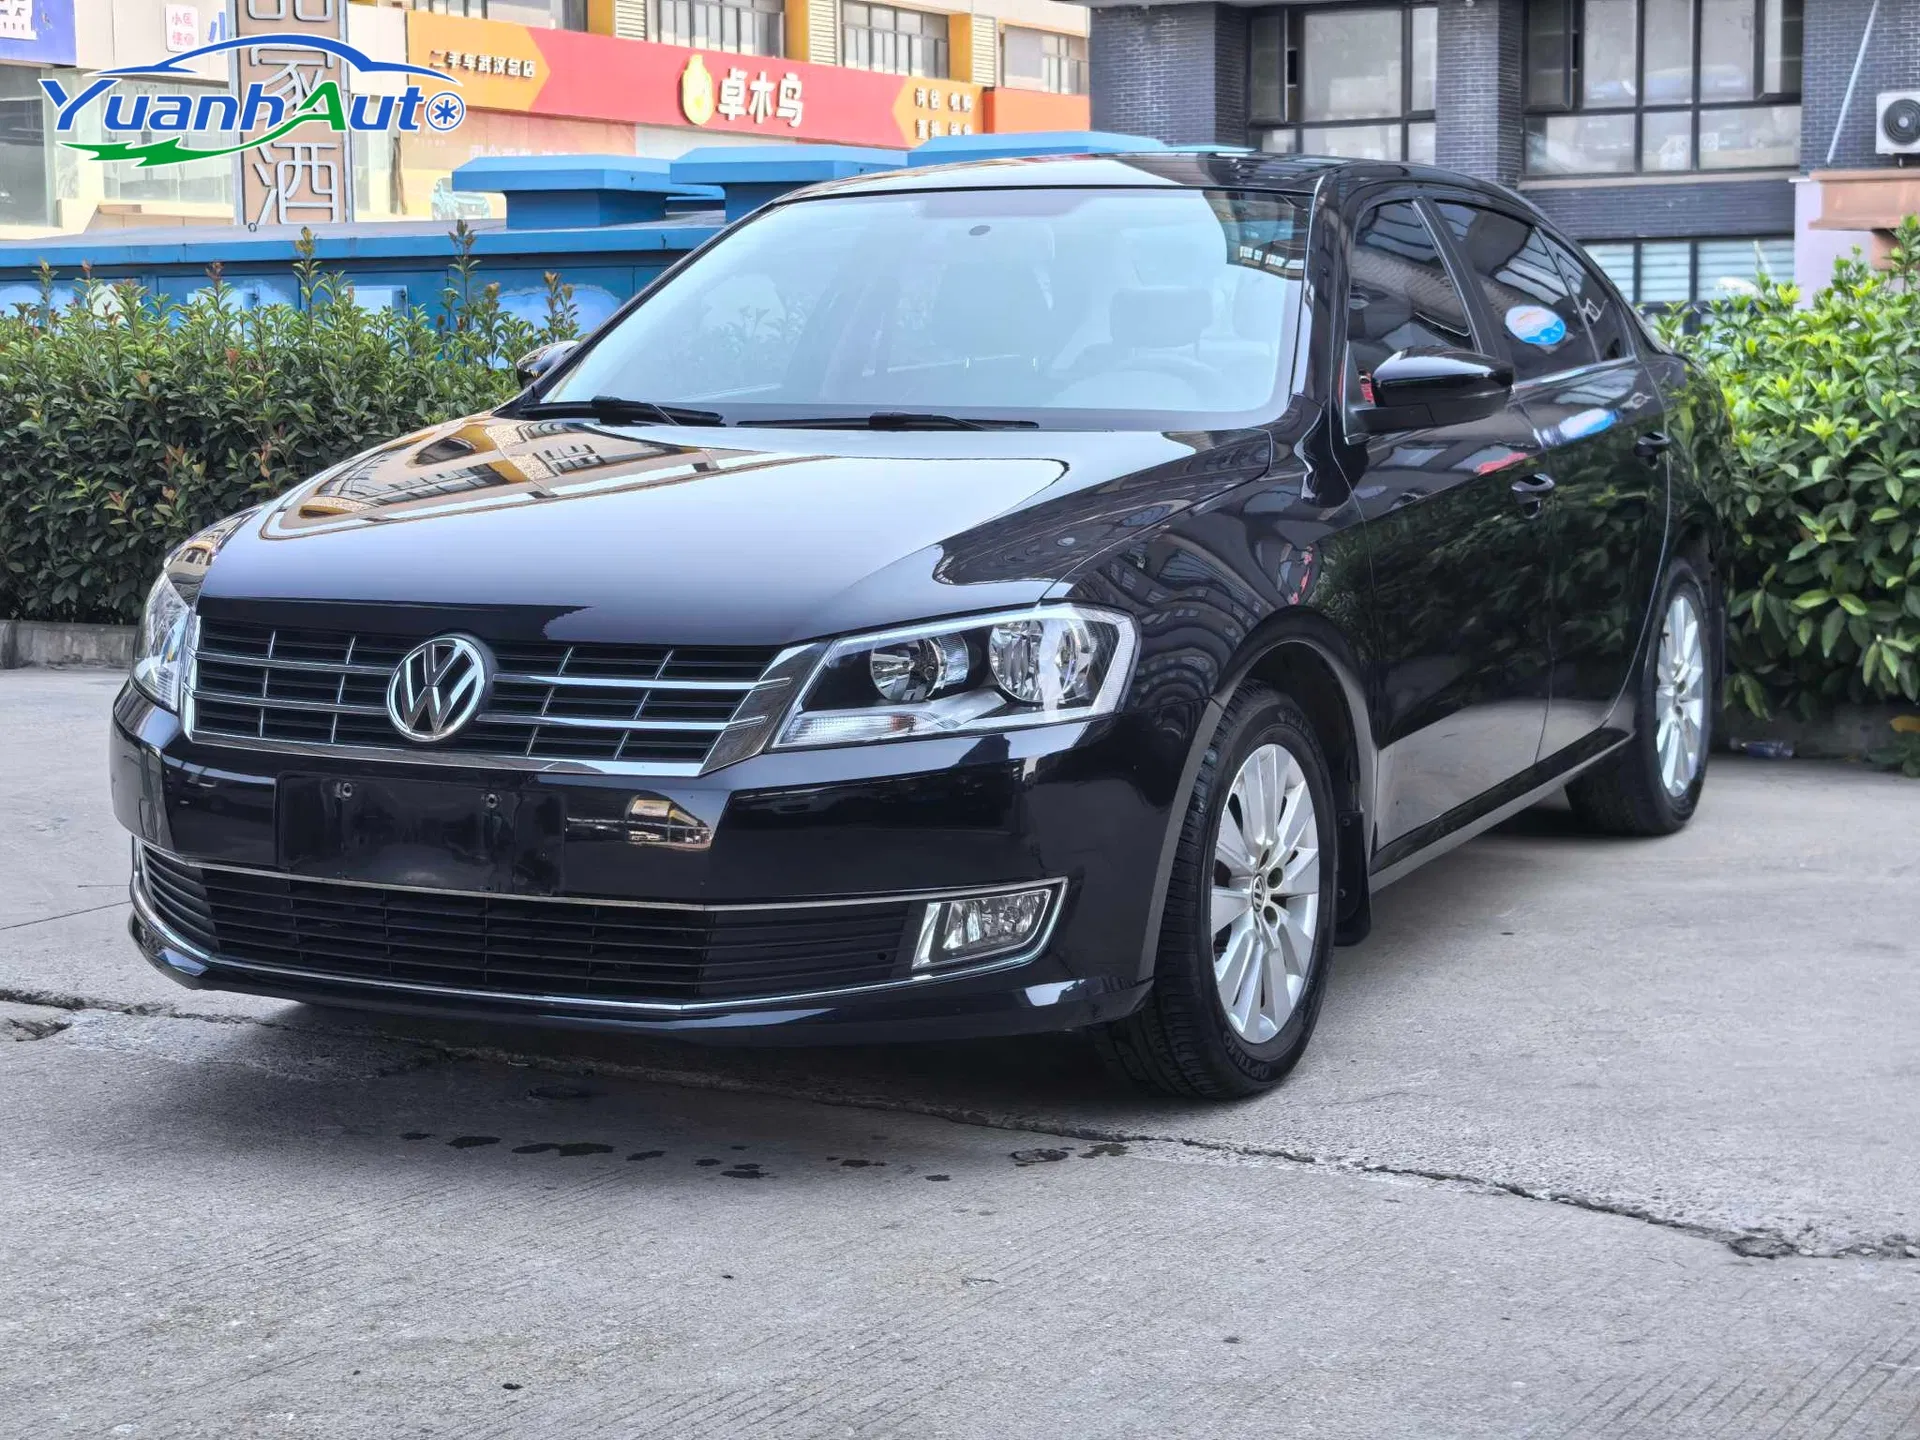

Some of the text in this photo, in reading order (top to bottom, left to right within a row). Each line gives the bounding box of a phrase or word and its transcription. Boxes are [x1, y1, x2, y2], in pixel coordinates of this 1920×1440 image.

[717, 67, 803, 127] 卓木鸟
[388, 638, 485, 741] VW
